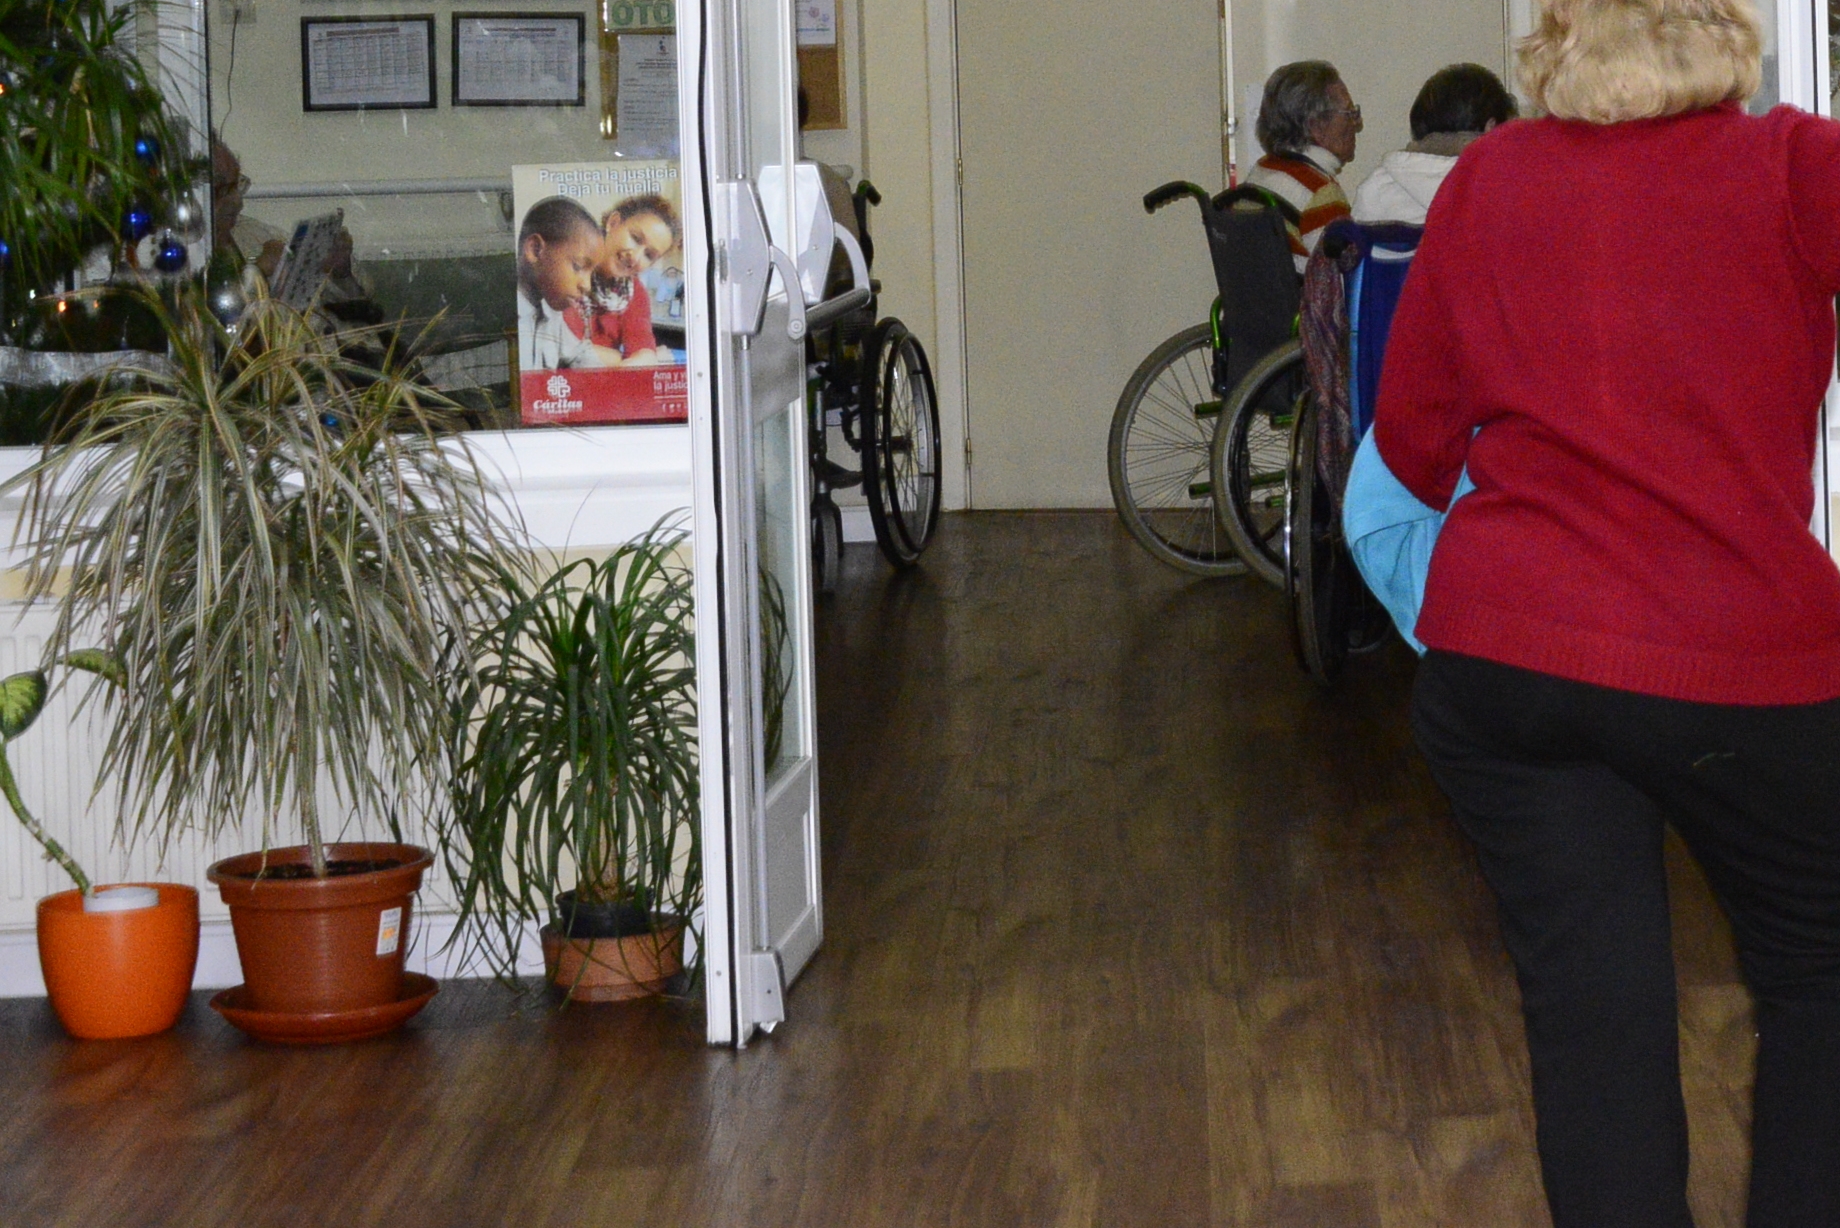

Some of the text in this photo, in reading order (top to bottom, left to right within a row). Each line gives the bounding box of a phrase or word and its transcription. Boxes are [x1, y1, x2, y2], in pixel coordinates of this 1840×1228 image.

[539, 165, 678, 183] Practica la justicia
[557, 179, 662, 197] Deja tu huella
